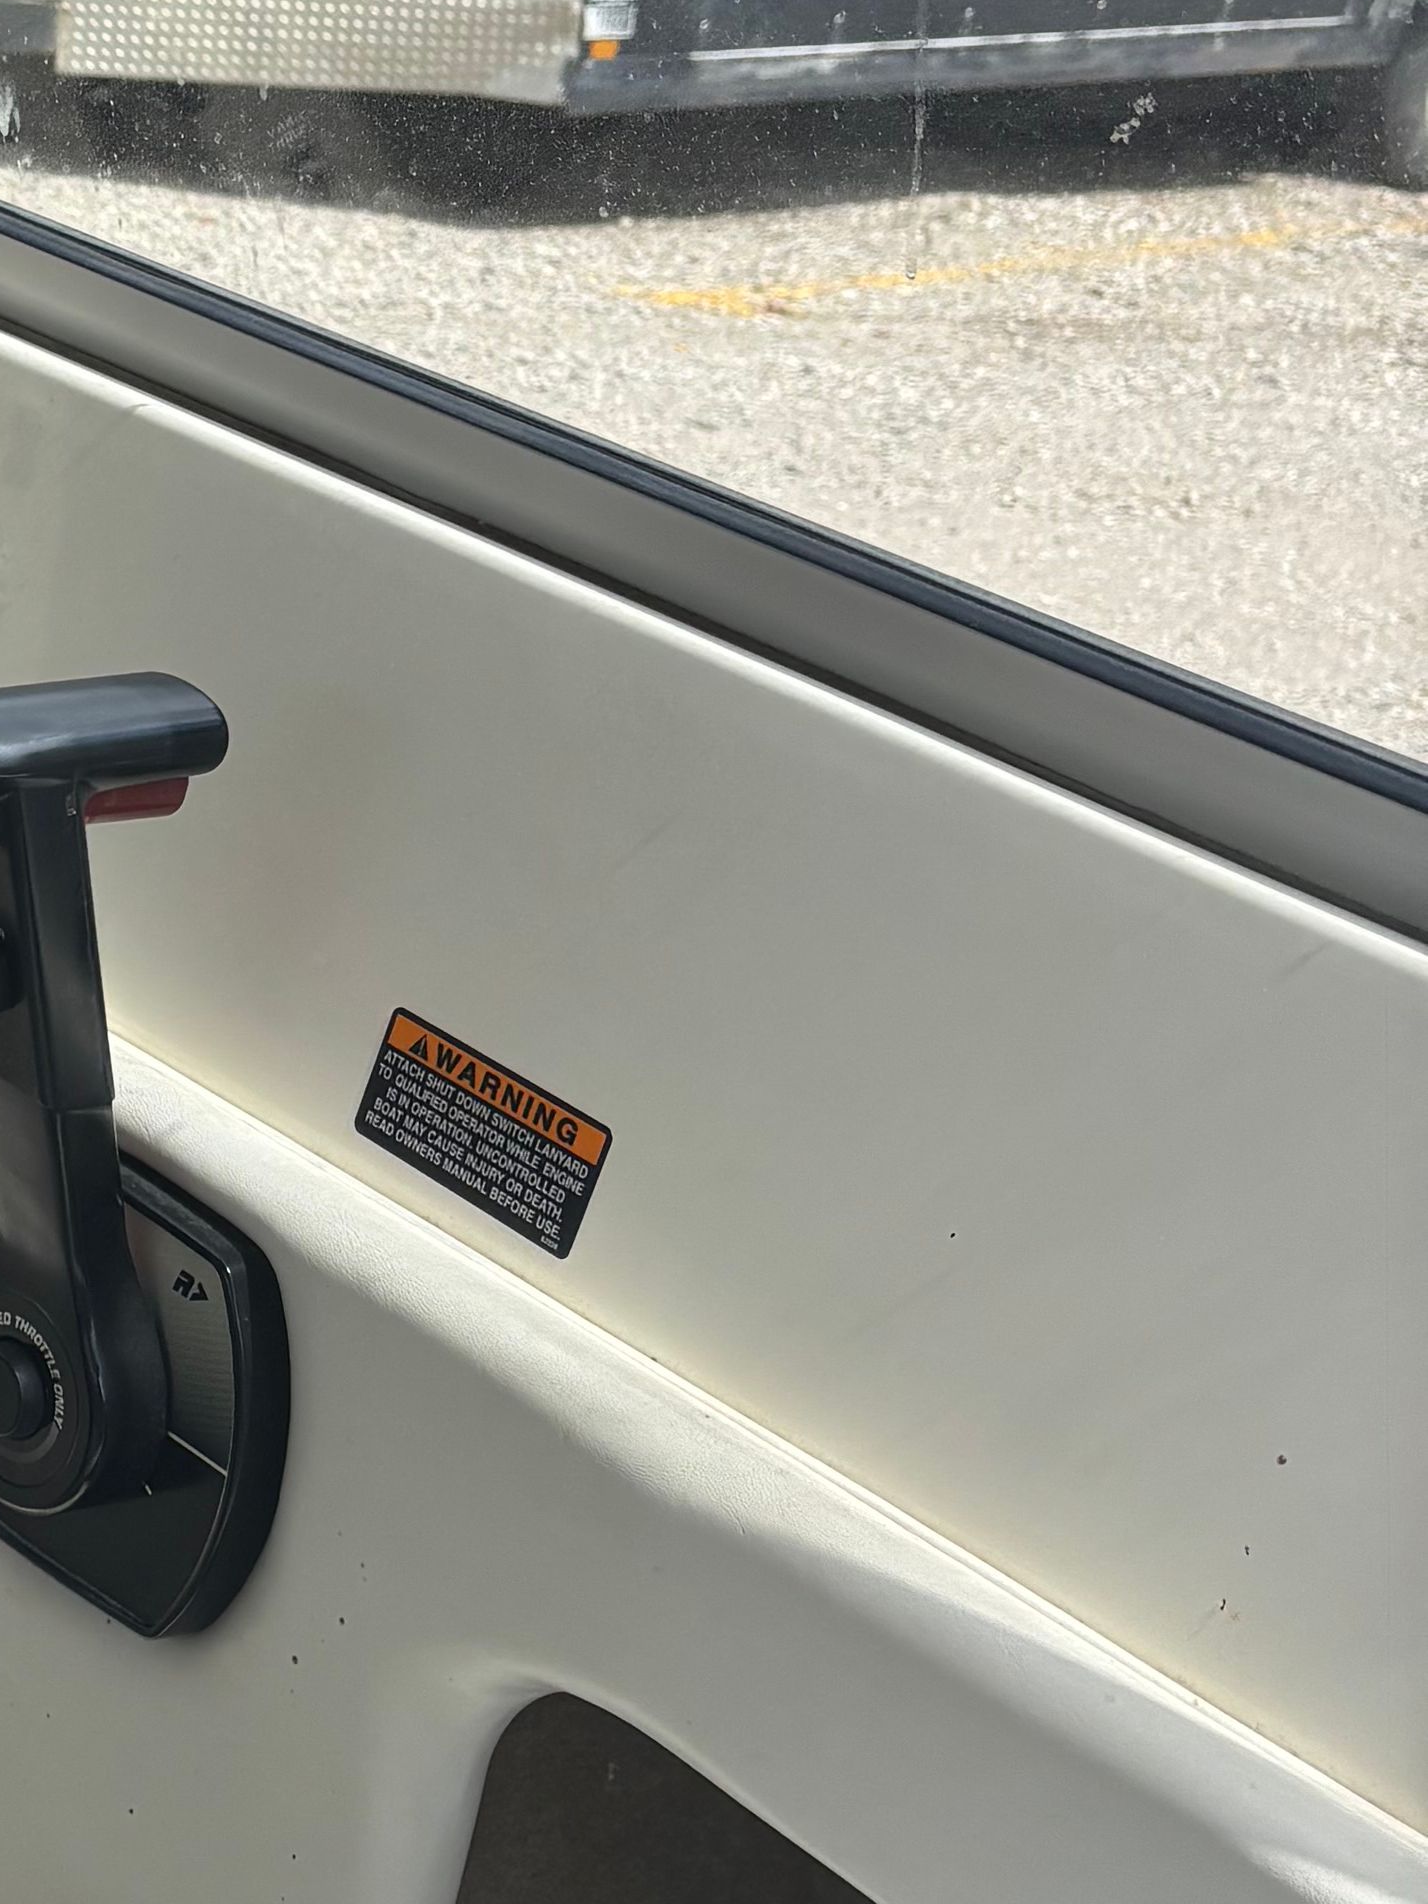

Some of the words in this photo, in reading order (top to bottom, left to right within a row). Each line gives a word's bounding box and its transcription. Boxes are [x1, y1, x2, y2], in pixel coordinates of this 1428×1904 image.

[373, 1096, 402, 1123] BOAT
[402, 1114, 427, 1138] MAY
[427, 1129, 464, 1160] CAUSE
[464, 1151, 504, 1186] INJURY
[505, 1176, 522, 1196] OR
[378, 1063, 392, 1080] TO
[395, 1073, 447, 1113] QUALIFIED
[448, 1104, 505, 1148] OPERATOR
[506, 1140, 540, 1169] WHILE
[542, 1162, 584, 1196] ENGINE
[384, 1049, 425, 1081] ATTACH
[425, 1073, 455, 1100] SHUT
[455, 1090, 491, 1121] DOWN
[491, 1111, 535, 1148] SWITCH
[535, 1138, 588, 1179] LANYARD
[385, 1085, 397, 1102] IS
[398, 1093, 411, 1109] IN
[411, 1101, 472, 1147] OPERATION.
[475, 1139, 565, 1204] UNCONTROLLED
[434, 1043, 579, 1146] WARNING
[364, 1109, 393, 1136] READ
[395, 1128, 441, 1166] OWNERS
[442, 1157, 486, 1194] MANUAL
[489, 1185, 535, 1224] BEFORE
[535, 1214, 560, 1239] USE.
[14, 1315, 61, 1381] THROTTLE
[52, 1384, 65, 1430] ONLY
